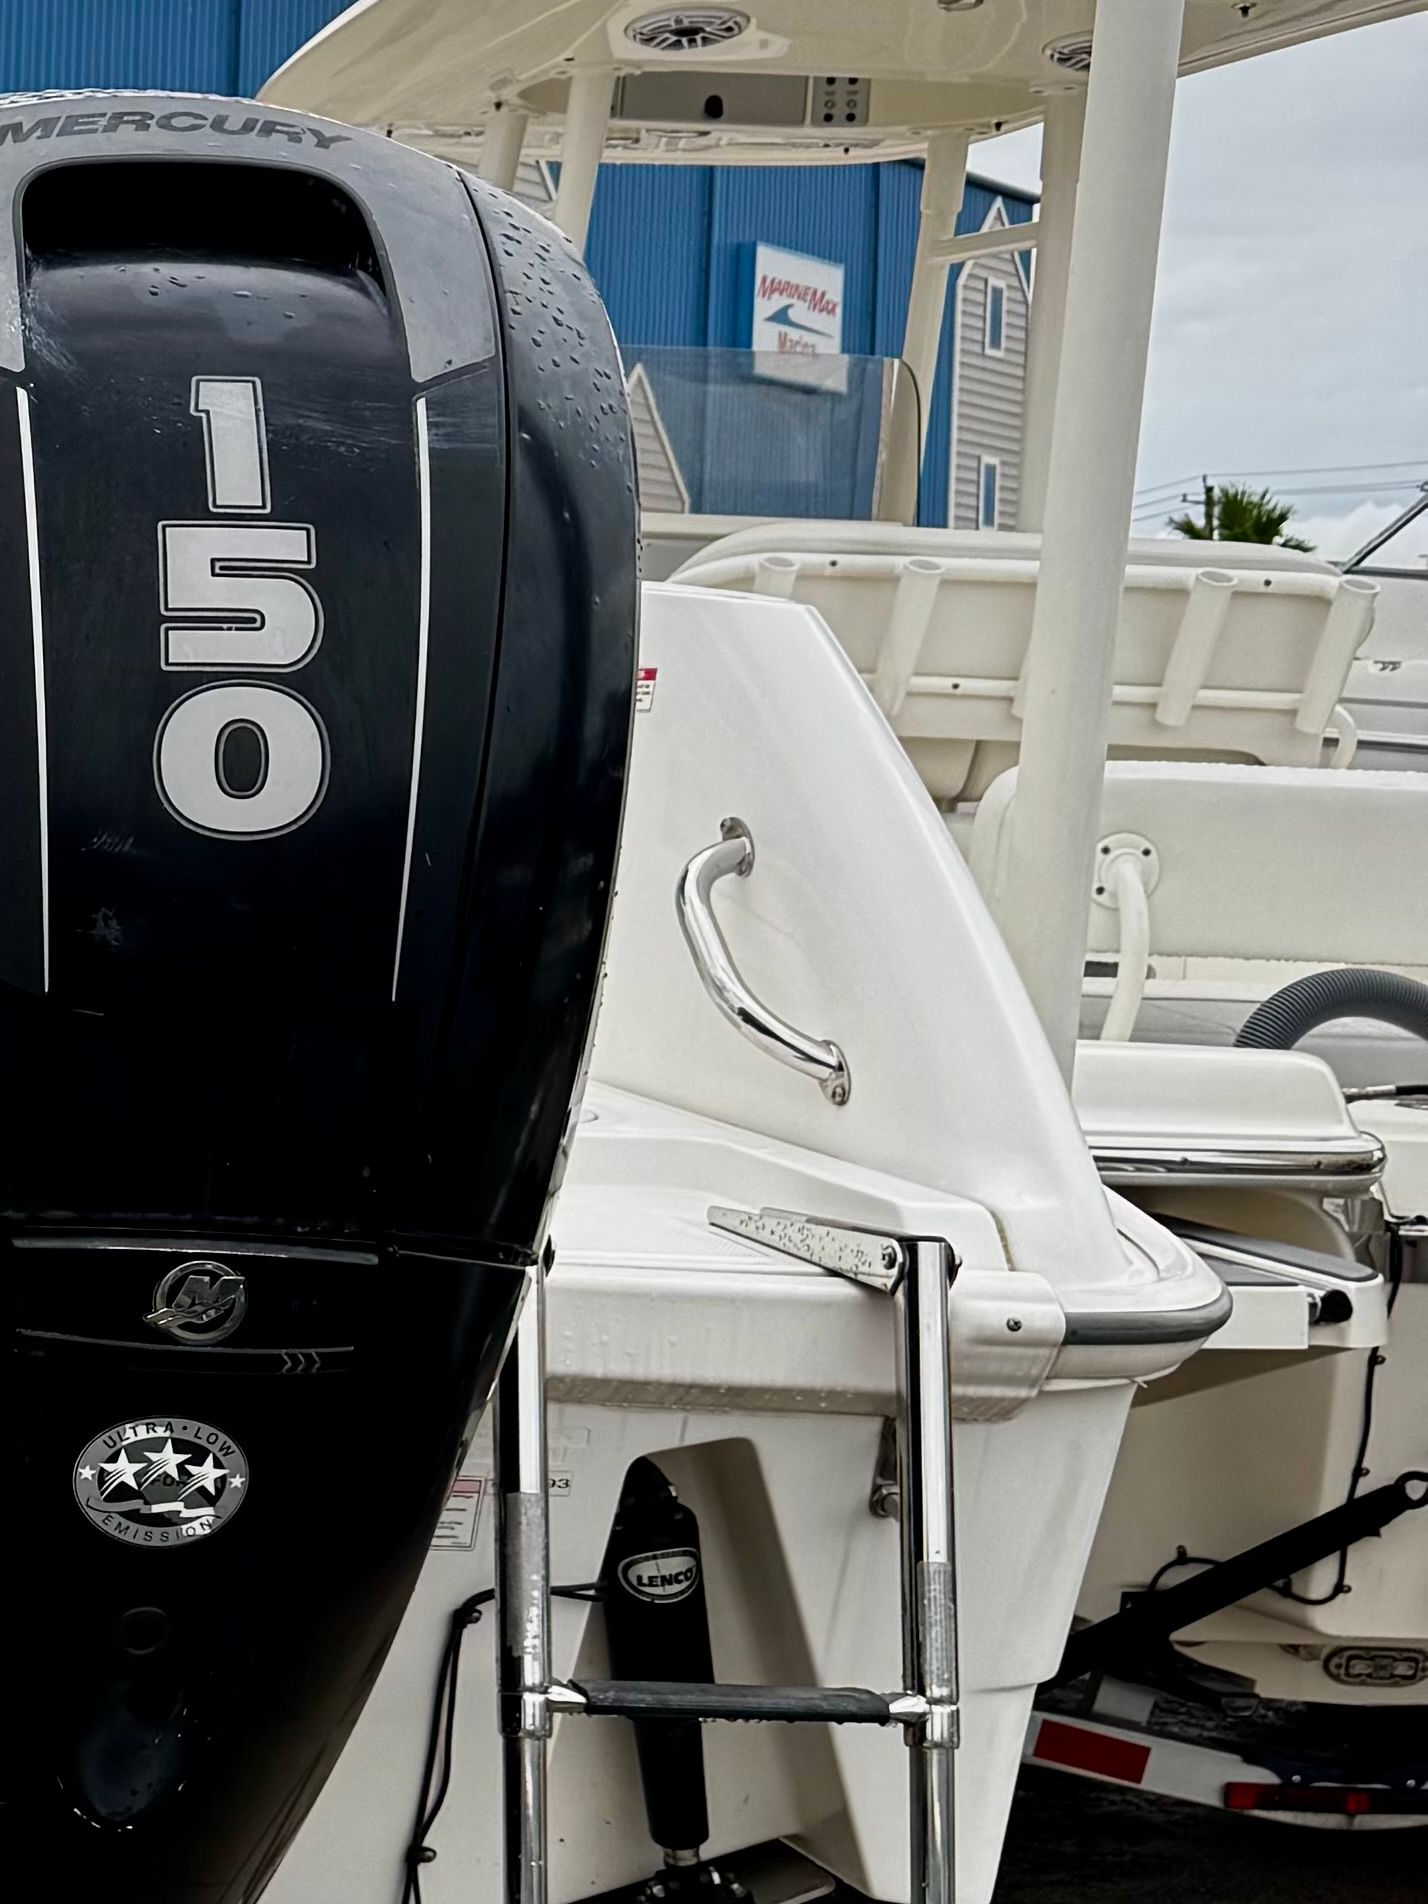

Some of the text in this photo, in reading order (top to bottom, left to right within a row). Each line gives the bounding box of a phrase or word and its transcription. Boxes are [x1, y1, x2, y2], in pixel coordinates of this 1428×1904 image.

[153, 376, 332, 842] 150
[102, 1421, 236, 1459] ULTRA LOW
[101, 1513, 214, 1543] EMISSION
[636, 1566, 695, 1588] LENCO
